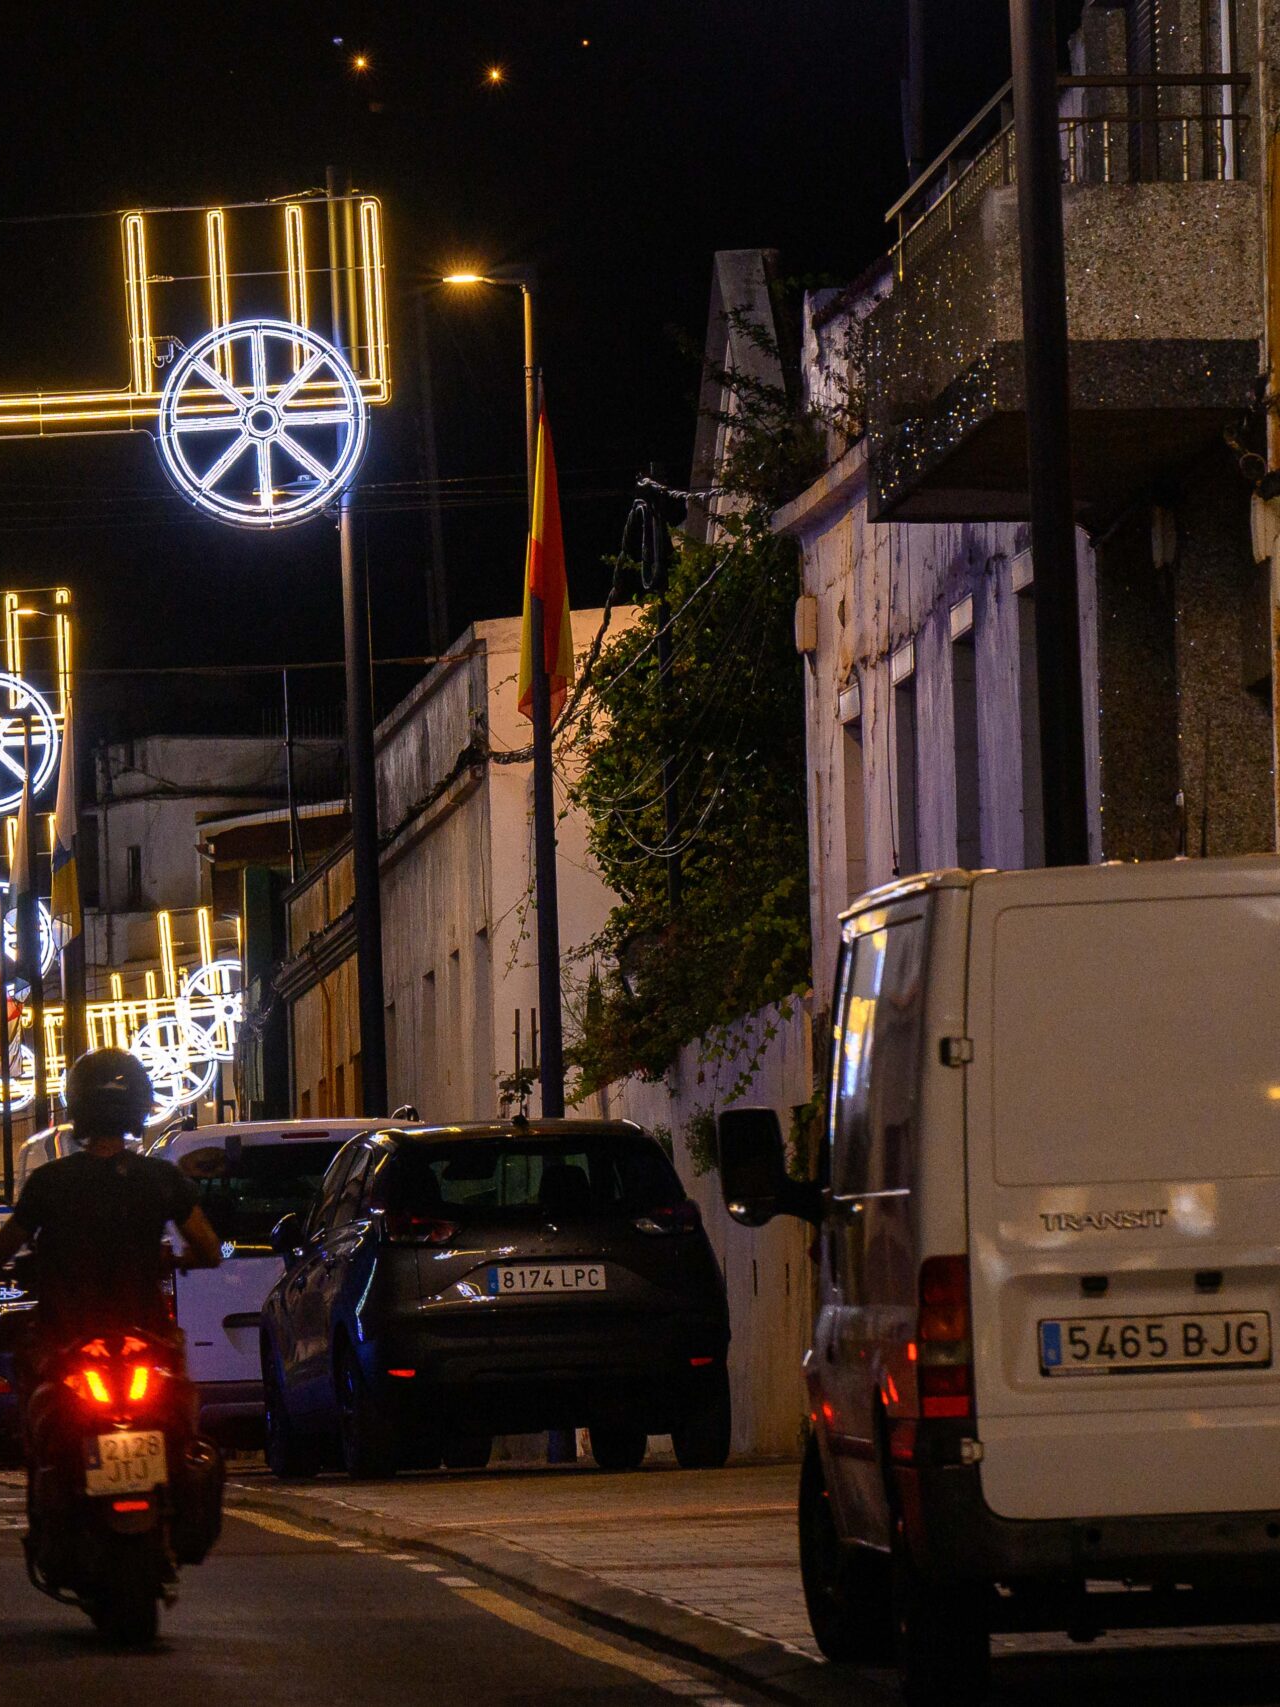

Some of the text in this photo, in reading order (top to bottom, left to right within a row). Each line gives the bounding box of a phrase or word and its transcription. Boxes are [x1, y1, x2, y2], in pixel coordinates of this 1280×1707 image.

[1040, 1209, 1168, 1232] TRANSIT
[503, 1268, 599, 1289] 8174 LPC
[1069, 1321, 1258, 1361] 5465 BJG
